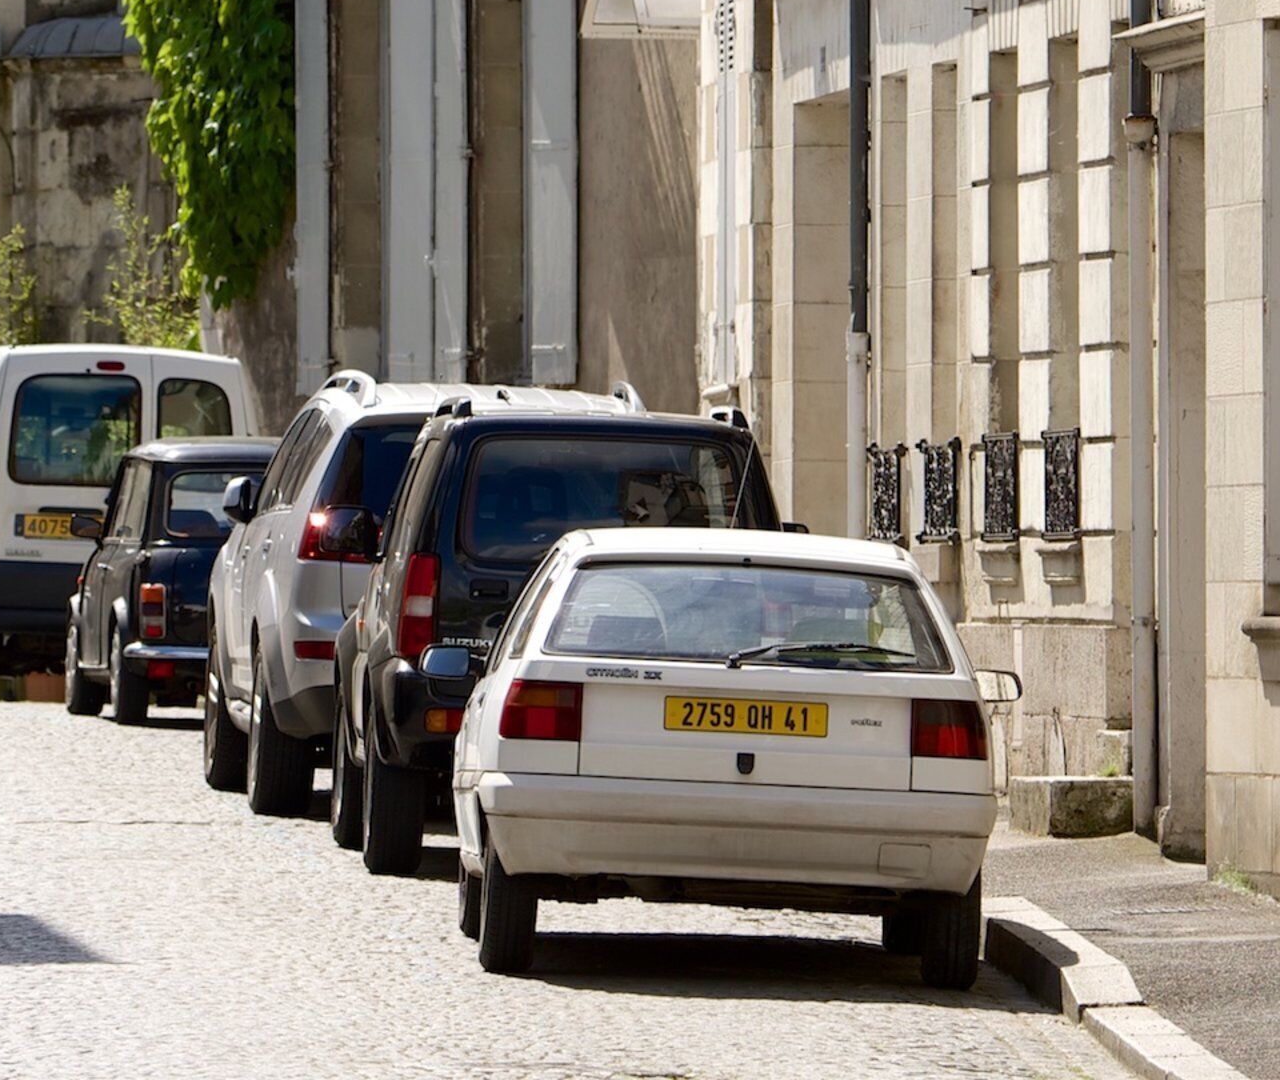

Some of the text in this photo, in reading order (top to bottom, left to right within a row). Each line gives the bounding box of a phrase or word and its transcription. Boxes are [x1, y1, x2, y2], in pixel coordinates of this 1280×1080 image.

[682, 702, 808, 731] 2759 QH 41
